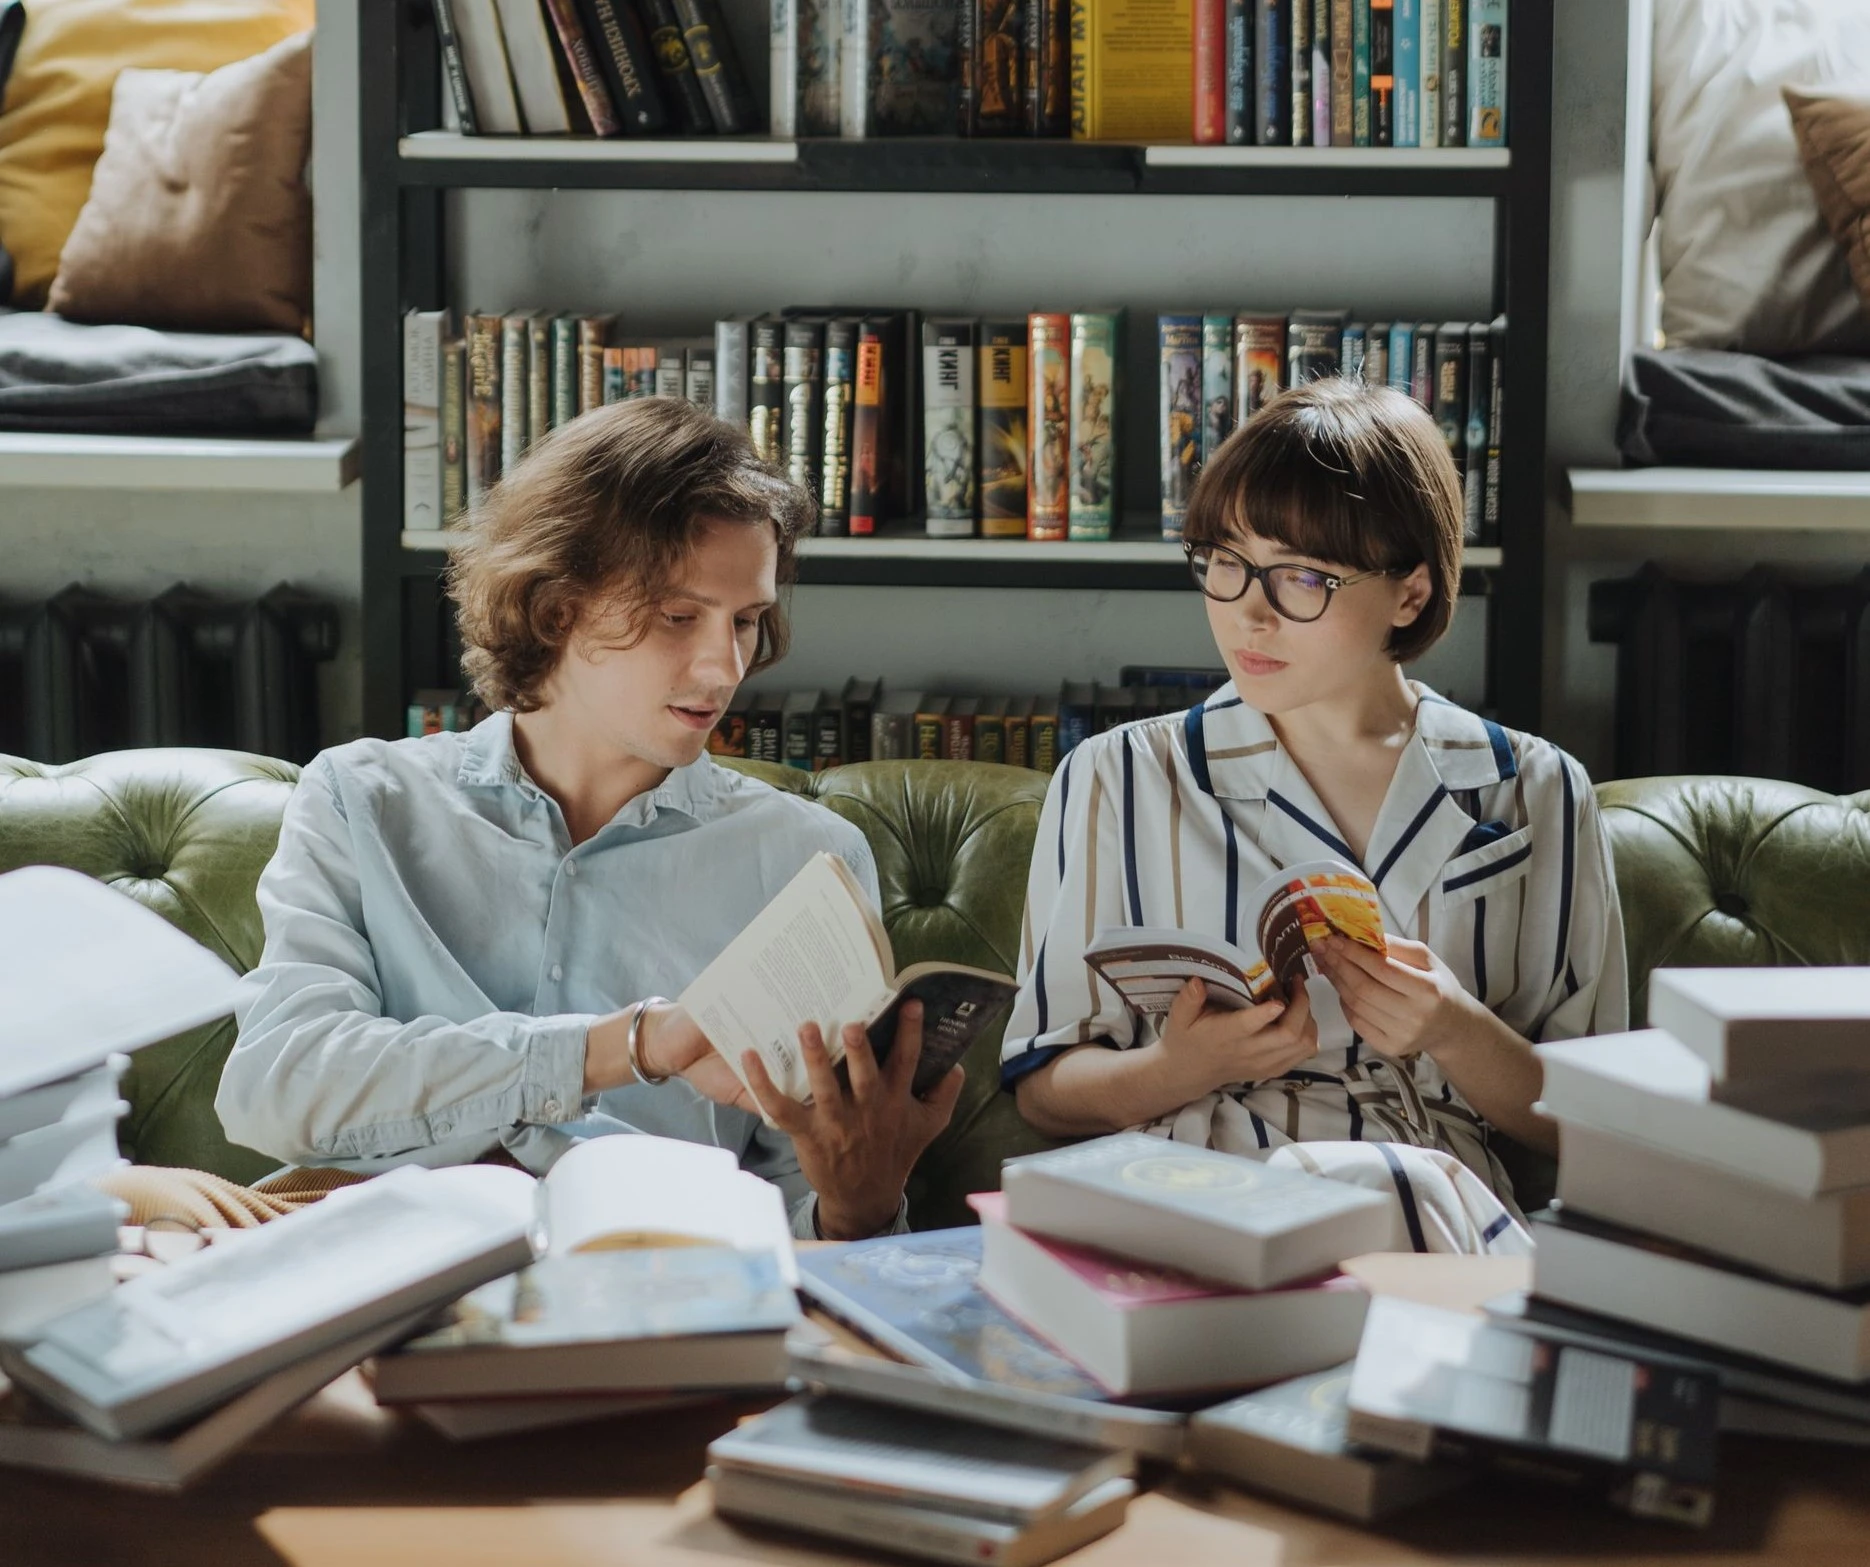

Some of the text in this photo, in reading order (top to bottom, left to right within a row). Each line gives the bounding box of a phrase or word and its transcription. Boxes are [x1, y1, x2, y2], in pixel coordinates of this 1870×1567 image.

[571, 37, 602, 96] ХОББИТ
[605, 19, 641, 98] ХРОНИКИ
[1071, 53, 1085, 134] АЛАН
[422, 335, 435, 392] ОДИНА
[938, 349, 959, 391] КИНГ
[992, 348, 1012, 384] КИНГ
[1486, 456, 1500, 484] BOOK
[1484, 486, 1498, 521] ESCAPE
[1167, 953, 1230, 974] Bel-Ami
[939, 1016, 967, 1029] HENRIK
